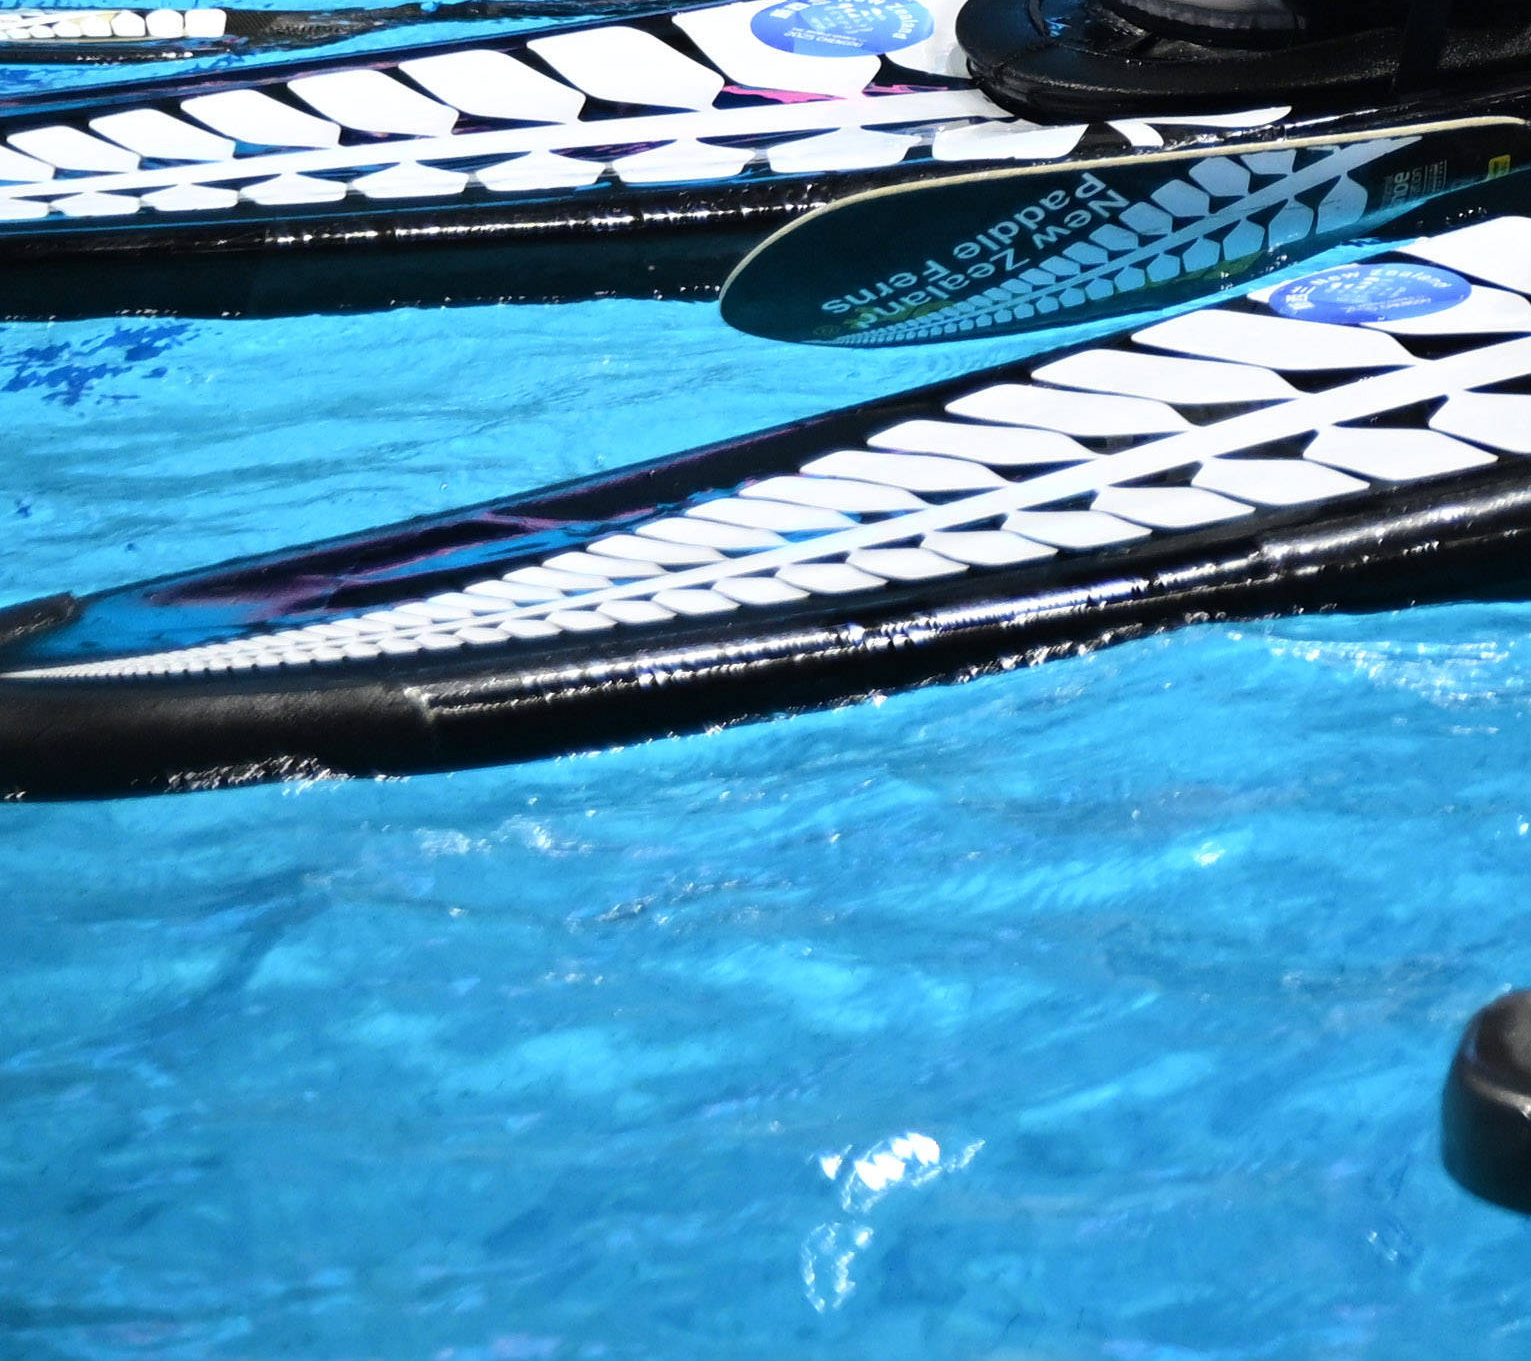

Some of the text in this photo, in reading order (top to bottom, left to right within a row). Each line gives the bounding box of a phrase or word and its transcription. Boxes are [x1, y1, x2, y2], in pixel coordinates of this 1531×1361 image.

[821, 172, 1106, 314] Paddle Ferns
[1032, 189, 1130, 250] New
